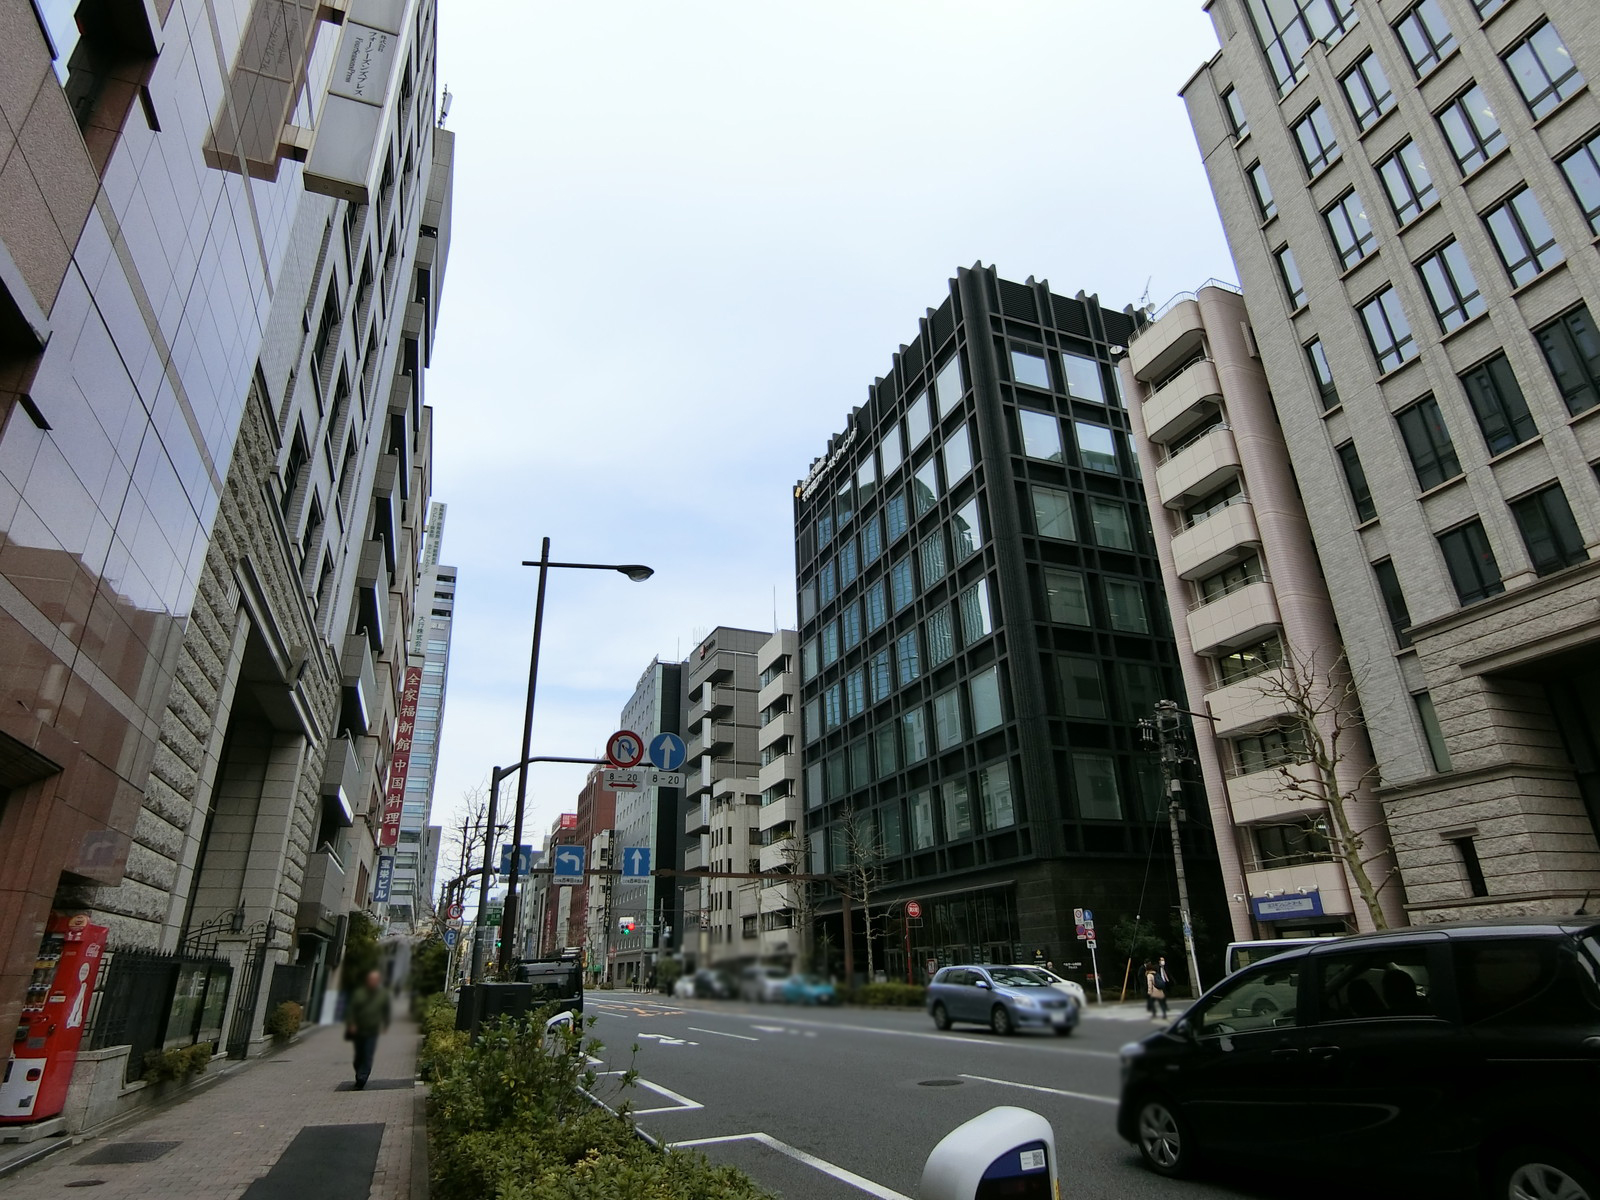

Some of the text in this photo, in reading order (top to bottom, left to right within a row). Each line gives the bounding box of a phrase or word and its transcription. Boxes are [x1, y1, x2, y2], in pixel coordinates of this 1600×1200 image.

[383, 673, 421, 826] 全家福新館 中国料理
[375, 859, 391, 900] 宝栄ビル
